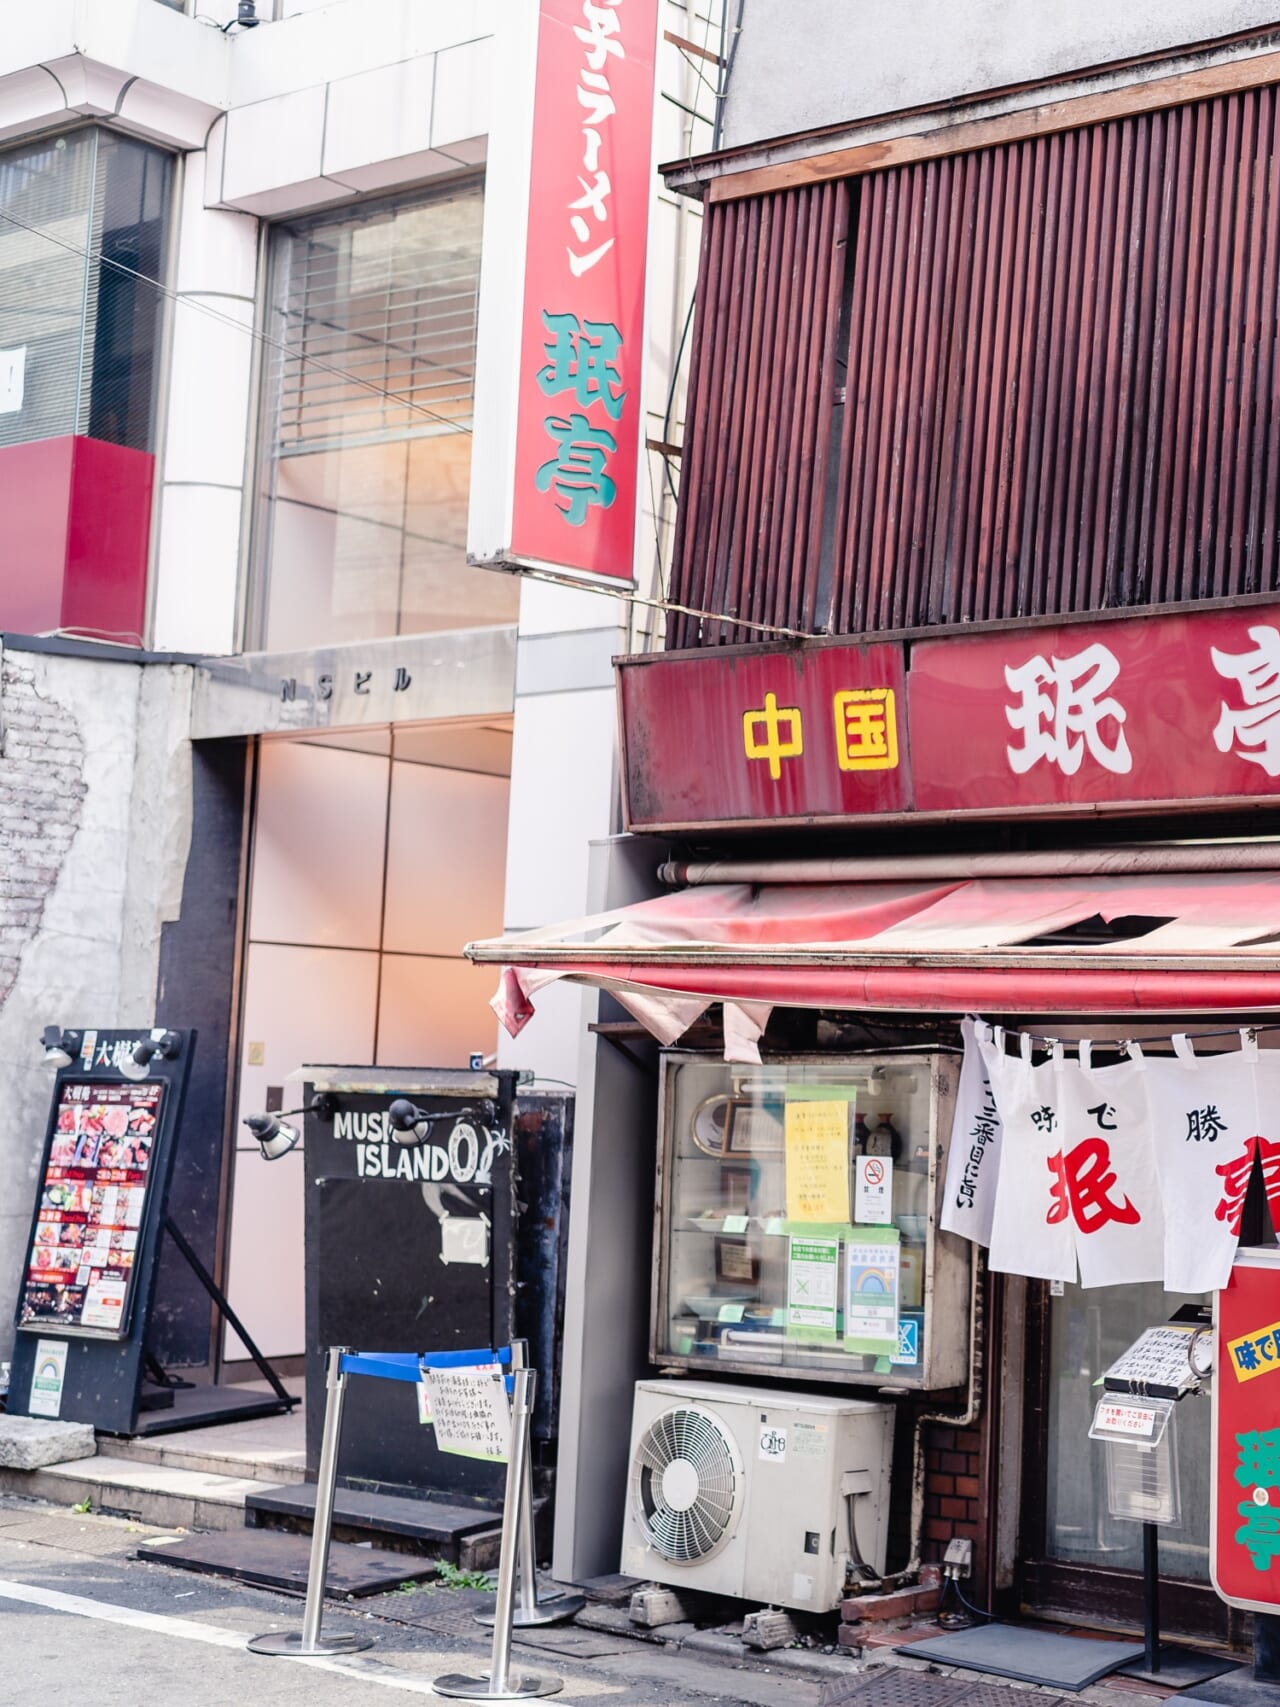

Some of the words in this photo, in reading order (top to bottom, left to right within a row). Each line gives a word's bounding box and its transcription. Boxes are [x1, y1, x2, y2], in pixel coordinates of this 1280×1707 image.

[566, 0, 625, 278] 子ラーメン
[743, 688, 900, 780] 中国
[356, 1144, 450, 1182] ISLAND
